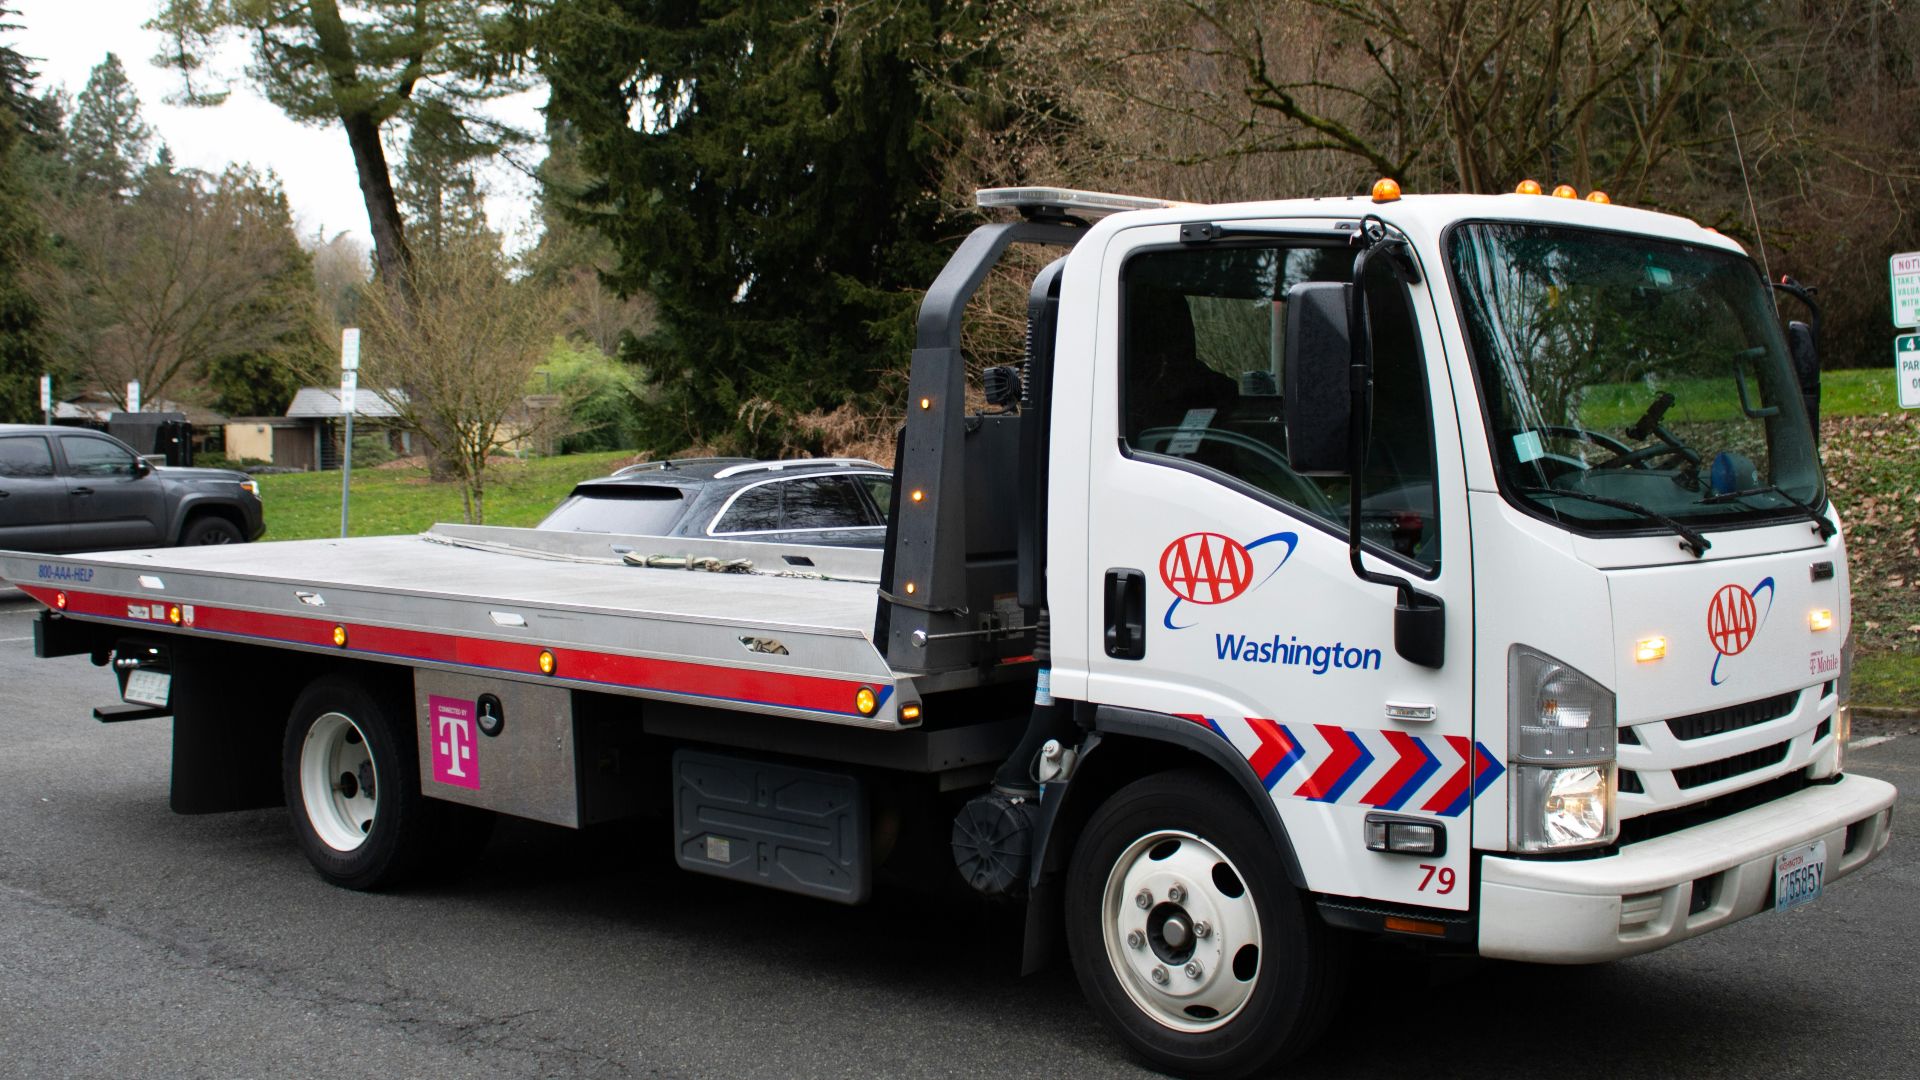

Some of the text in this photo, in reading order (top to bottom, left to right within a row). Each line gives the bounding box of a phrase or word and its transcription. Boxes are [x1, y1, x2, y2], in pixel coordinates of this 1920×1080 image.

[1906, 337, 1916, 351] 4
[38, 564, 94, 582] 800-AAA-HELP
[1164, 533, 1247, 603] AAA
[1711, 585, 1754, 655] AAA
[1215, 633, 1382, 675] Washington
[438, 716, 470, 778] T
[1417, 863, 1456, 895] 79
